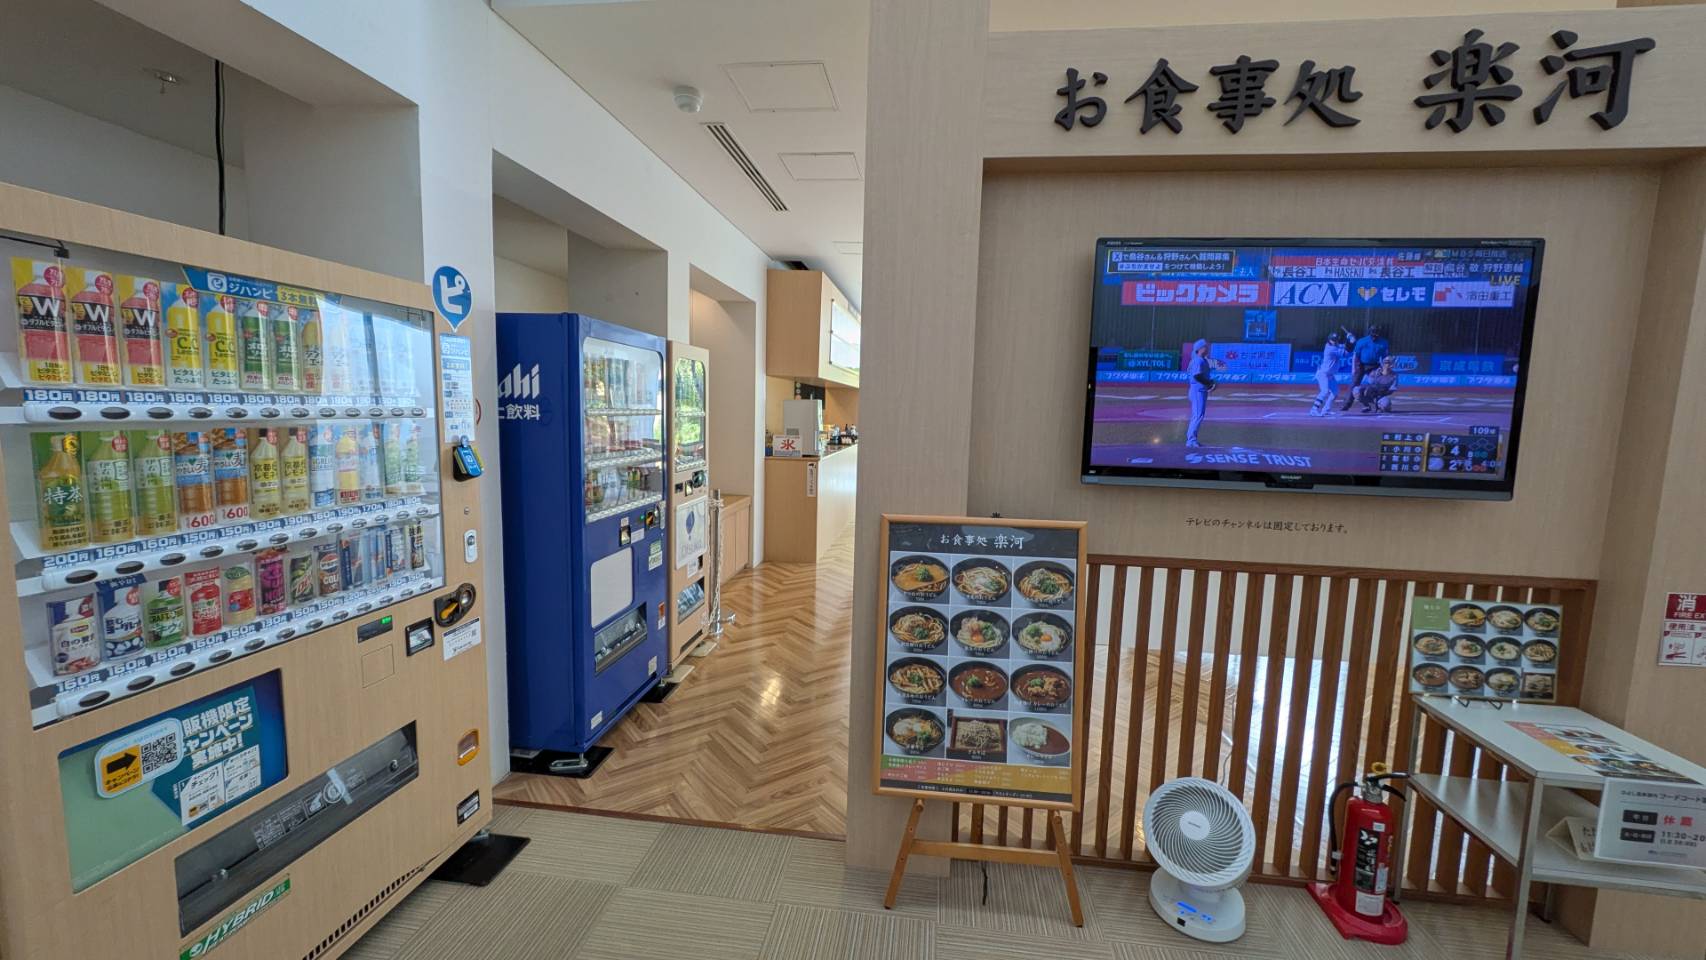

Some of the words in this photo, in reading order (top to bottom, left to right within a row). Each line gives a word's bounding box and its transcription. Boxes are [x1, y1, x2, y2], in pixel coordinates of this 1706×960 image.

[1054, 54, 1364, 135] お食事処
[1413, 28, 1657, 134] 楽河
[439, 274, 466, 315] ピ
[1134, 282, 1260, 304] ビックカメラ
[1276, 283, 1349, 305] ACN
[1380, 285, 1427, 303] セレモ
[31, 296, 61, 318] W
[83, 303, 110, 323] W
[132, 308, 157, 327] W
[24, 388, 73, 402] 180円
[76, 389, 121, 401] 180円
[124, 390, 164, 402] 180円
[169, 393, 204, 403] 180円
[208, 393, 240, 403] 180円
[243, 394, 272, 404] 180円
[1204, 453, 1260, 465] SENSE
[1263, 454, 1313, 468] TRUST
[44, 486, 84, 505] 特茶
[1185, 517, 1349, 534] テレビのチャンネルは固定しております。
[95, 544, 137, 559] 160円
[142, 535, 178, 551] 160円
[940, 534, 988, 547] お食事処
[993, 535, 1024, 550] 楽河
[43, 551, 89, 568] 200円
[1676, 593, 1698, 612] 消
[150, 643, 187, 663] 160円
[108, 658, 148, 678] 160円
[55, 672, 102, 694] 160円
[183, 712, 254, 755] ャンペーン
[202, 890, 274, 954] HYBRID
